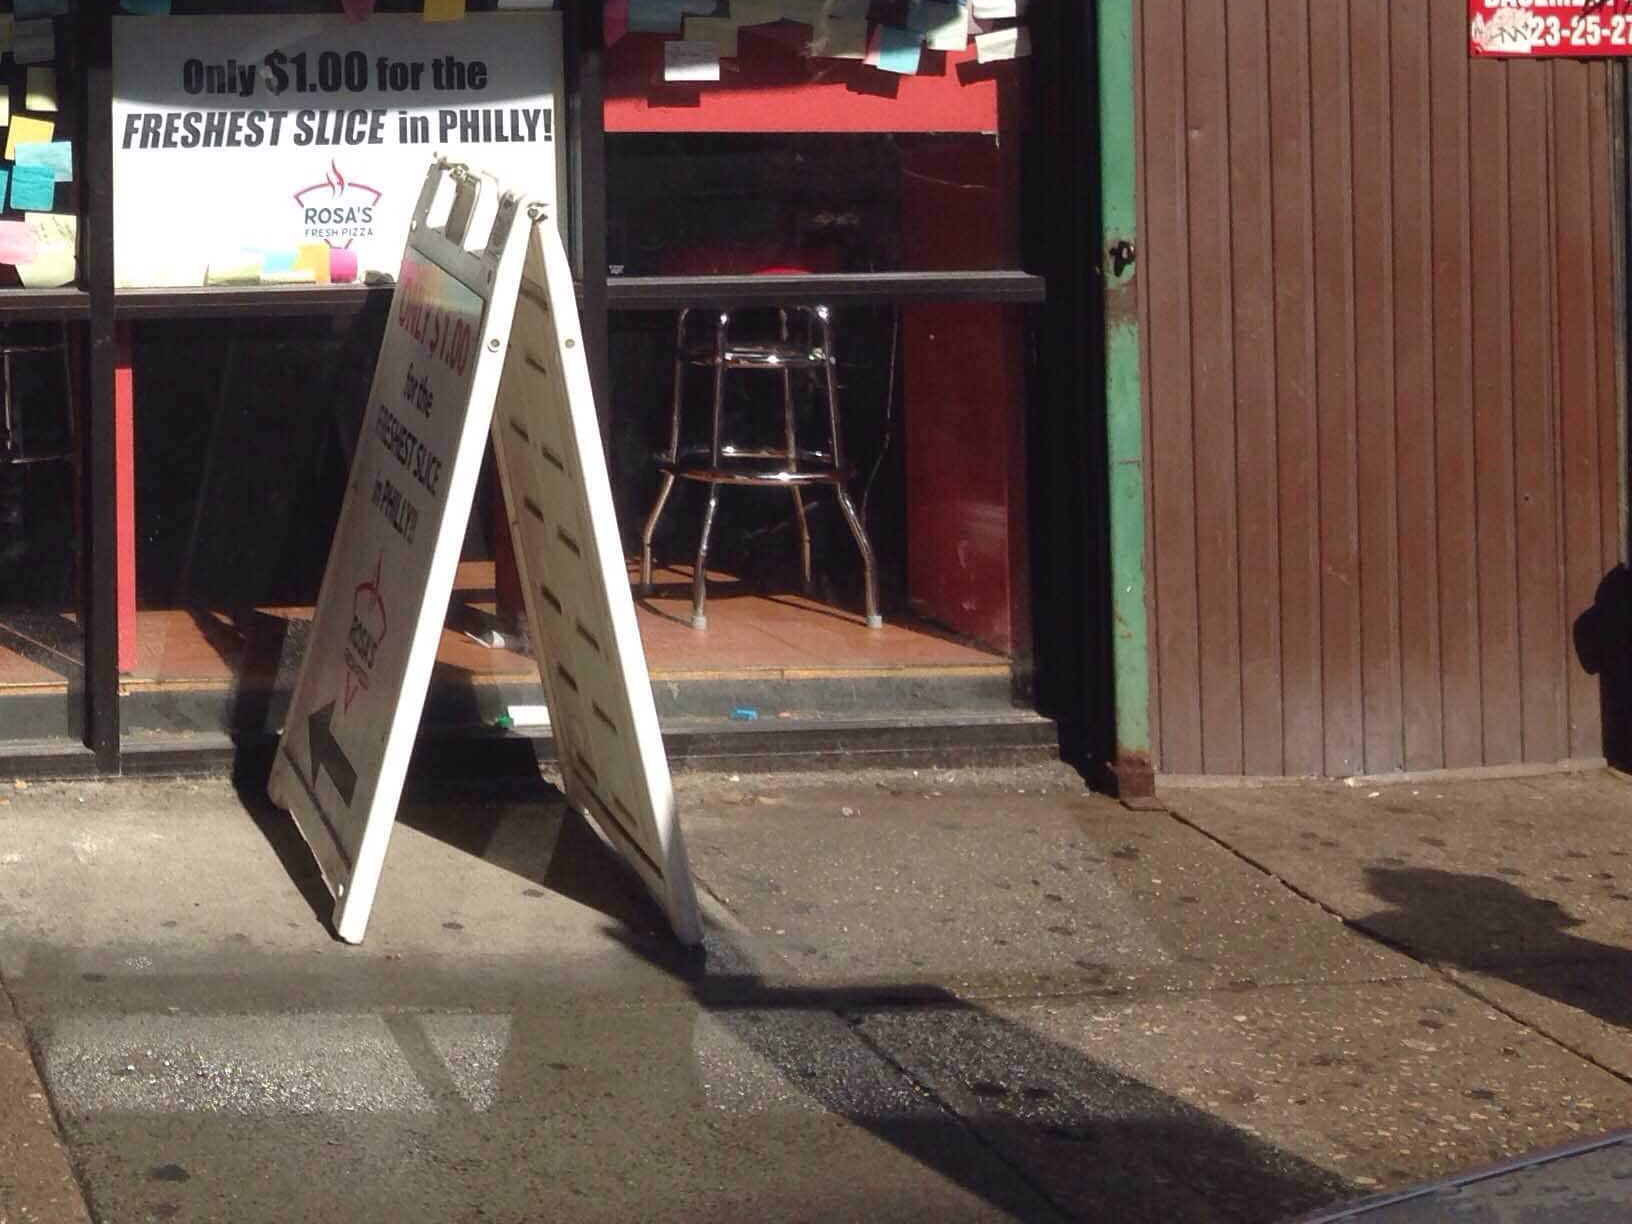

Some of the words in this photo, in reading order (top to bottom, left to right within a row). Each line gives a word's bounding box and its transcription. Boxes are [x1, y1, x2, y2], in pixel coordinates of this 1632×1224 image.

[183, 58, 257, 98] Only
[265, 49, 368, 96] $1.00
[376, 57, 425, 91] for
[432, 55, 488, 90] the
[122, 110, 289, 150] FRESHEST
[294, 108, 388, 146] SLICE
[398, 110, 430, 144] in
[439, 108, 553, 144] PHILLY!
[304, 206, 373, 225] ROSA'S
[305, 228, 338, 237] FRESH
[342, 228, 373, 237] PIZZA
